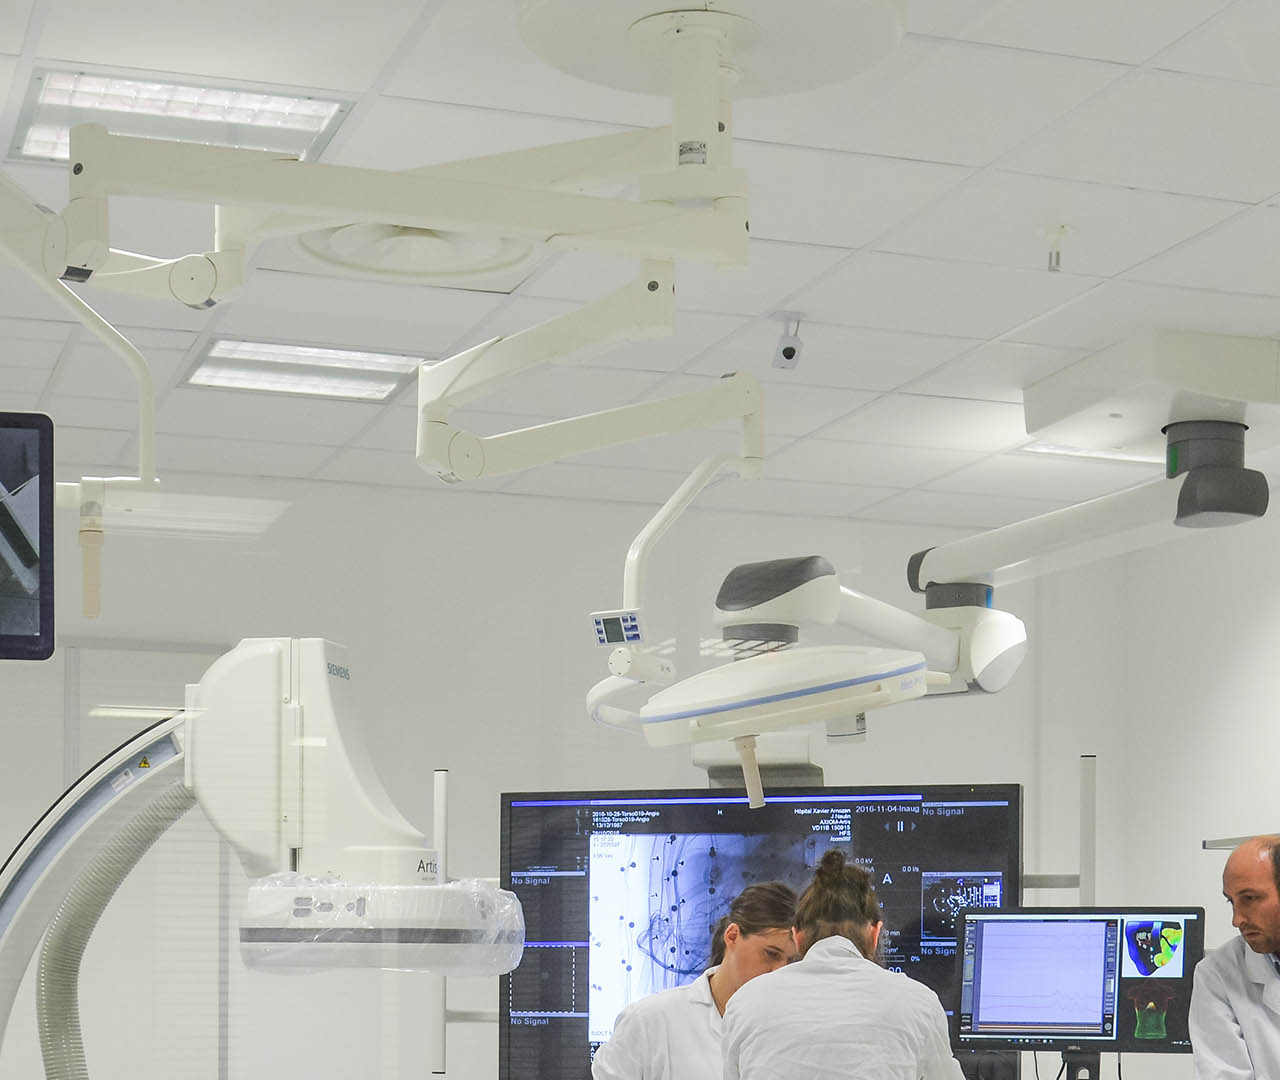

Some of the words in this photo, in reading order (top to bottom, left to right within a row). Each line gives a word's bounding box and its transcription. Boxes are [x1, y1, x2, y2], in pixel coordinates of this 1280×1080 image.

[327, 662, 350, 680] SIEMENS
[936, 807, 965, 817] Signal
[417, 859, 437, 874] Artis
[511, 877, 523, 885] No
[525, 876, 550, 886] Signal
[882, 873, 892, 884] A
[921, 947, 933, 955] No
[935, 947, 957, 956] Sign
[510, 1017, 522, 1025] No
[524, 1017, 549, 1026] Signal
